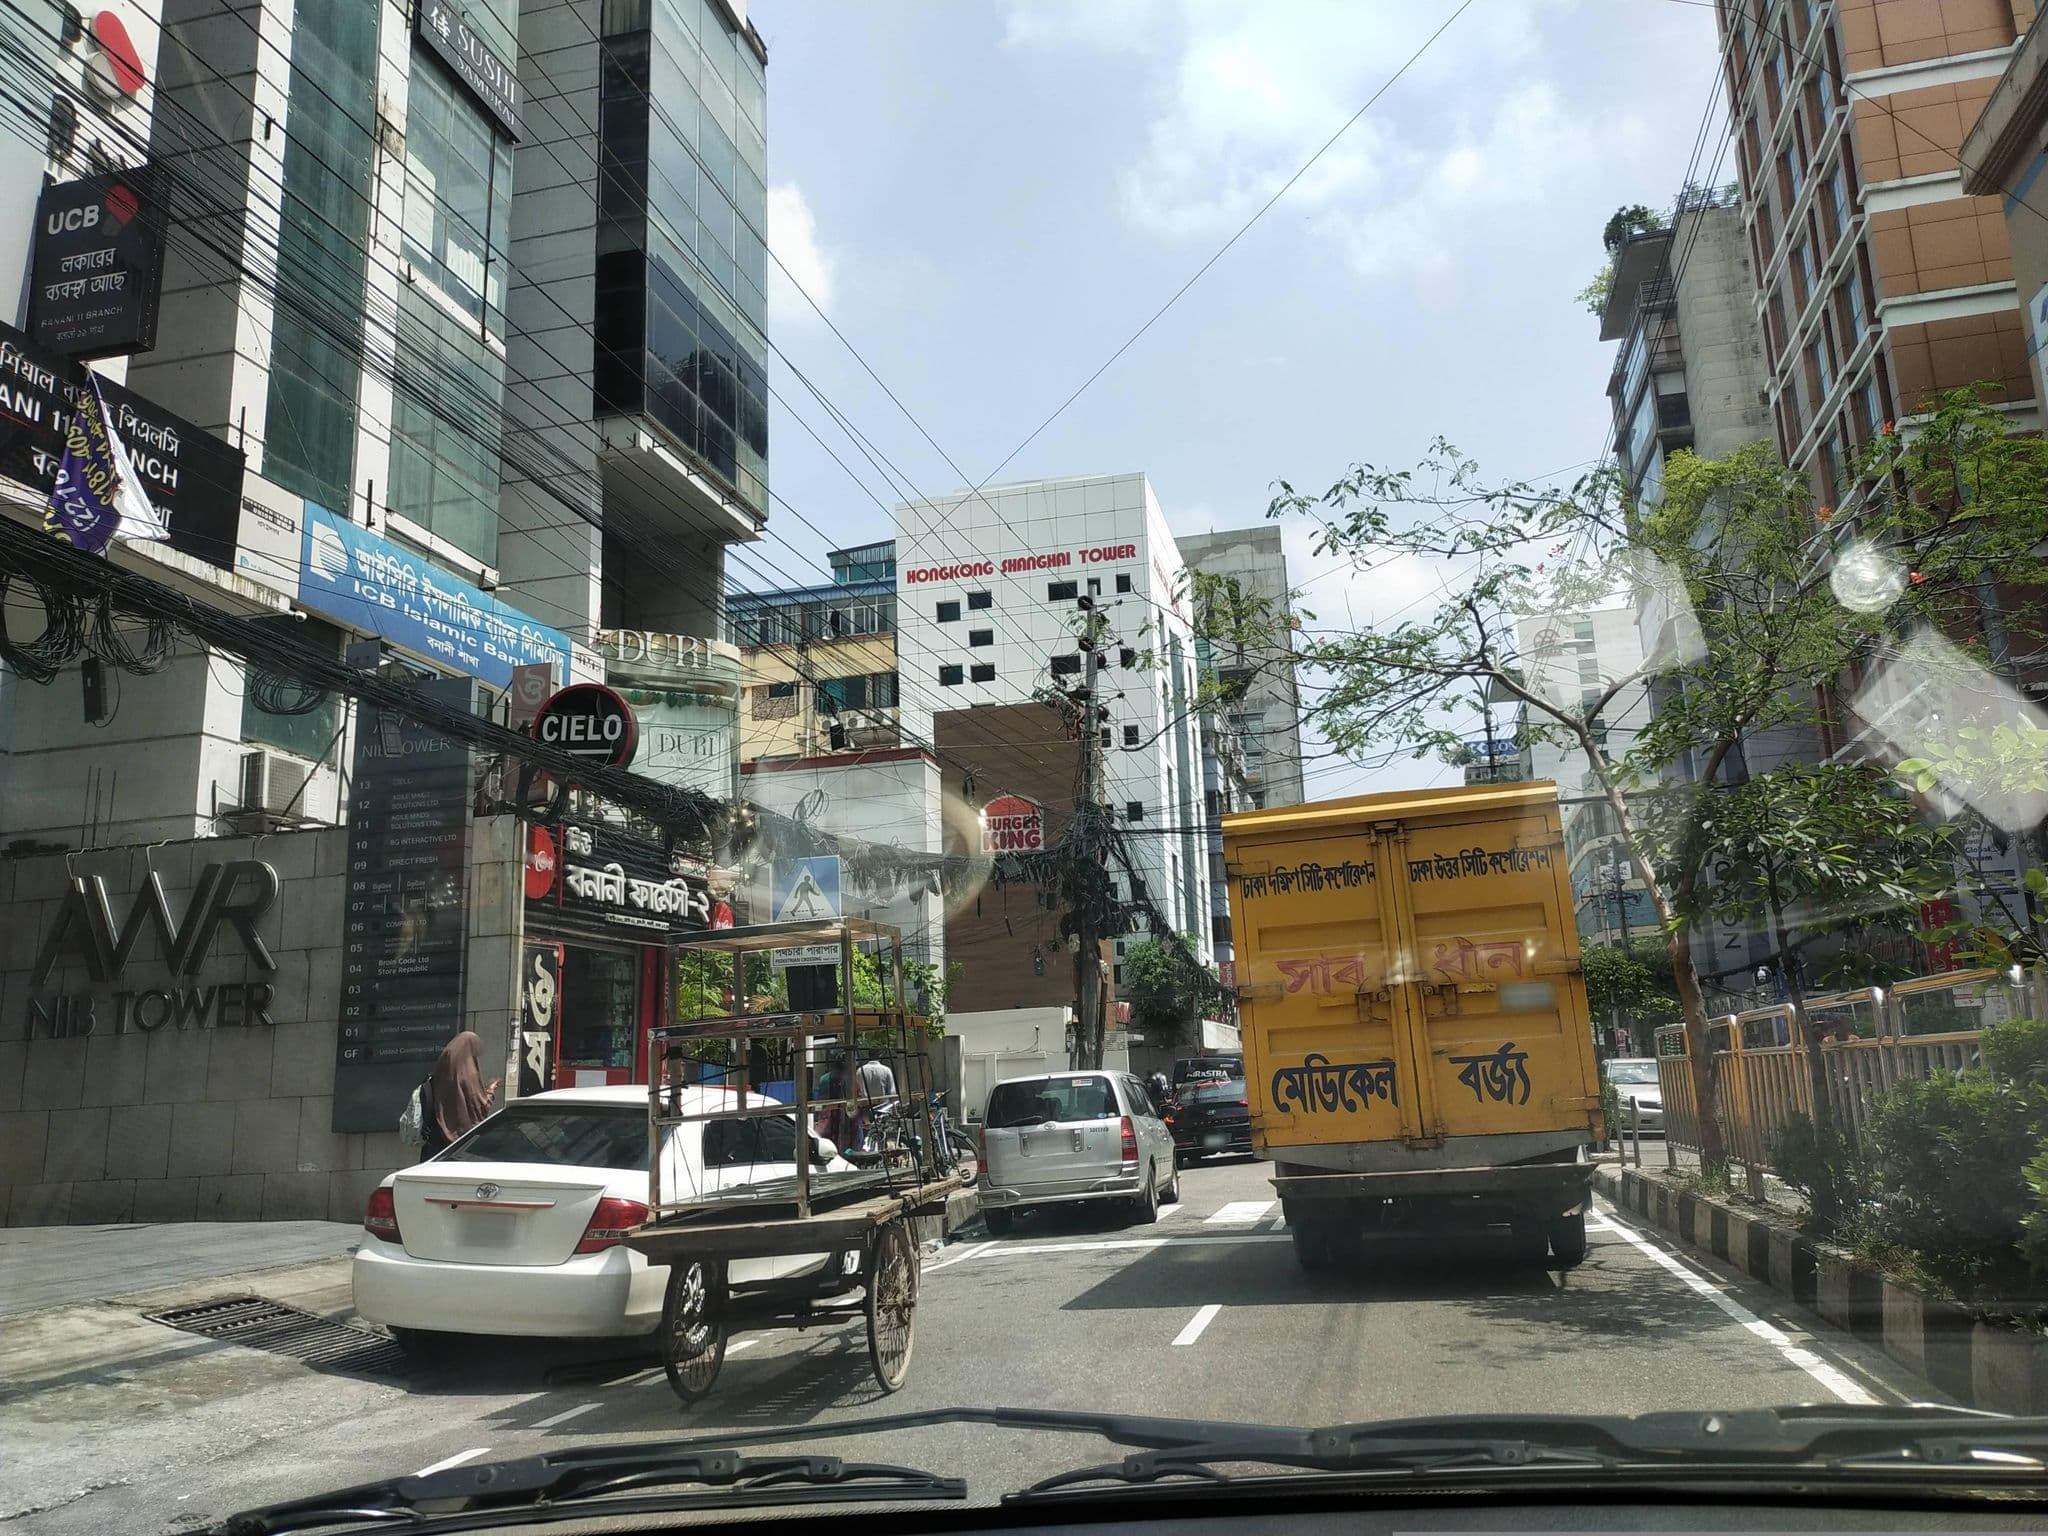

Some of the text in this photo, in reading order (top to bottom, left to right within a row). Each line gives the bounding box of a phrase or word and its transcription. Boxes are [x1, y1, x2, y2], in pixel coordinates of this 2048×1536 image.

[458, 24, 516, 104] SUSHI
[48, 204, 99, 235] UCB
[61, 248, 117, 273] লকারের
[44, 271, 128, 301] ব্যবস্থা আছে
[86, 305, 123, 320] BRANCH
[118, 404, 180, 458] পিএলসি
[906, 543, 1137, 585] HONGKONG SHANGHAI TOWER
[354, 547, 418, 600] আইসিবি
[420, 574, 482, 634] ইসলামিক
[484, 609, 518, 652] ব্যাংক
[520, 624, 564, 668] লিমিটেড
[354, 580, 397, 609] ICB
[403, 602, 478, 648] Islamic
[426, 634, 480, 669] বনানী শাখা
[610, 628, 716, 672] DURI
[542, 714, 623, 742] CIELO
[401, 736, 452, 755] OWER
[659, 733, 715, 758] DURI
[360, 781, 370, 790] 13
[359, 801, 370, 810] 12
[358, 821, 369, 830] 11
[356, 841, 368, 849] 10
[400, 835, 444, 845] INTERACTIVE
[565, 826, 593, 856] নিউ
[983, 829, 1041, 851] KING
[354, 856, 438, 870] 09 DIRECT FRESH
[1408, 860, 1434, 882] ঢাকা
[1434, 853, 1460, 879] উত্তর
[1460, 847, 1488, 877] সিটি
[353, 881, 366, 891] 08
[565, 862, 626, 906] বনানী
[1240, 875, 1267, 899] ঢাকা
[1268, 866, 1301, 895] দক্ষিণ
[1300, 863, 1324, 892] সিটি
[352, 902, 365, 911] 07
[30, 859, 280, 985] AWR
[351, 923, 364, 932] 06
[350, 944, 363, 953] 05
[398, 958, 417, 966] Code
[418, 956, 430, 964] Ltd
[349, 965, 362, 974] 04
[398, 965, 429, 975] Republic
[348, 985, 361, 994] 03
[26, 983, 275, 1041] NIB TOWER
[346, 1006, 360, 1016] 02
[345, 1028, 359, 1037] 01
[344, 1049, 359, 1058] GF
[1271, 1041, 1532, 1114] মেডিকেল বর্জ্য
